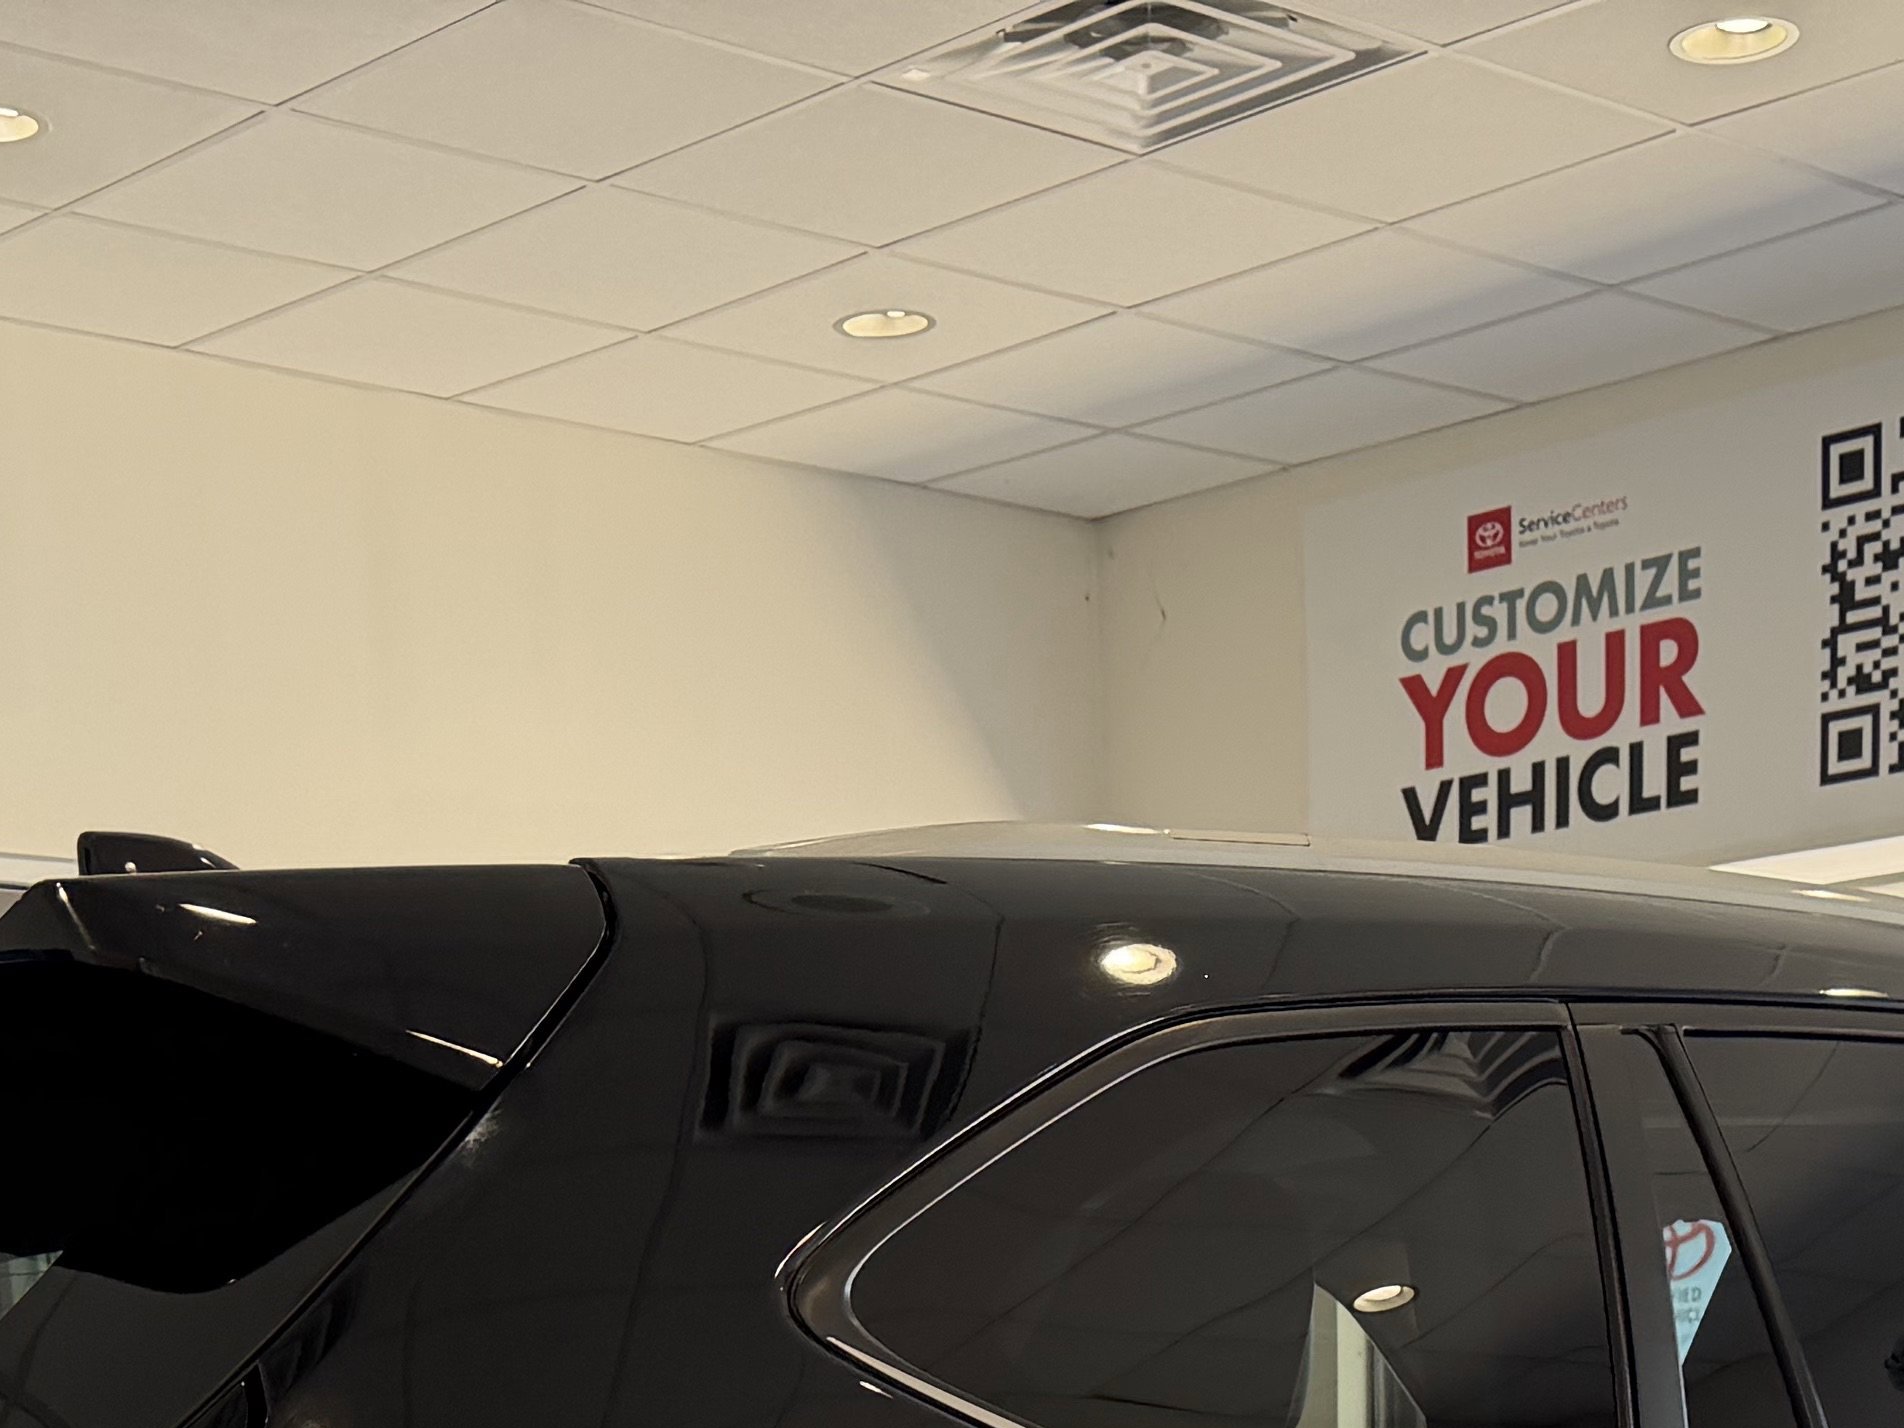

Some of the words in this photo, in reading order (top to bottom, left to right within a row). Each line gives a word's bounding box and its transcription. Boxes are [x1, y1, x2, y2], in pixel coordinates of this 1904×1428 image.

[1401, 547, 1701, 662] CUSTOMIZE
[1399, 617, 1705, 771] YOUR
[1401, 730, 1700, 844] VEHICLE
